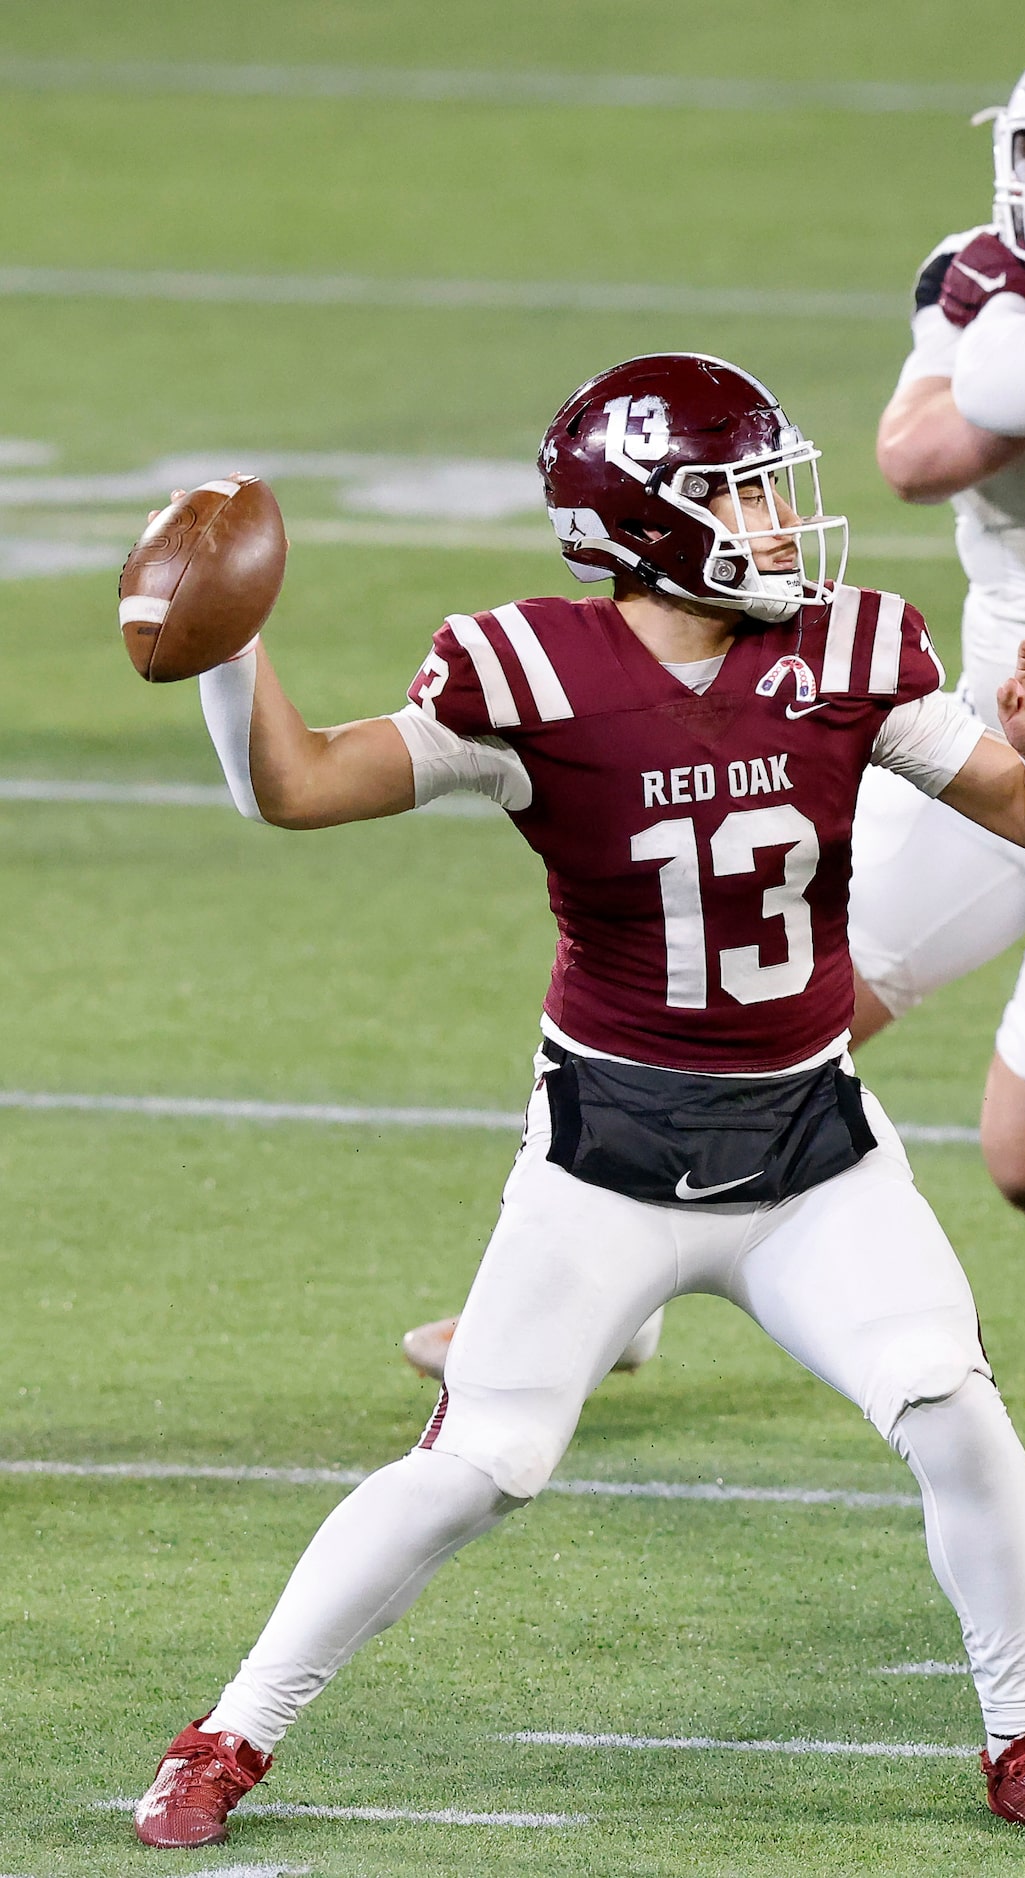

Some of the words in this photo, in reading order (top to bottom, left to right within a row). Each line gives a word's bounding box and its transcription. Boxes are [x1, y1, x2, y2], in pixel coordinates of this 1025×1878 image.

[603, 395, 670, 463] 13
[641, 763, 716, 808] RED
[727, 753, 794, 798] OAK
[630, 803, 820, 1010] 13
